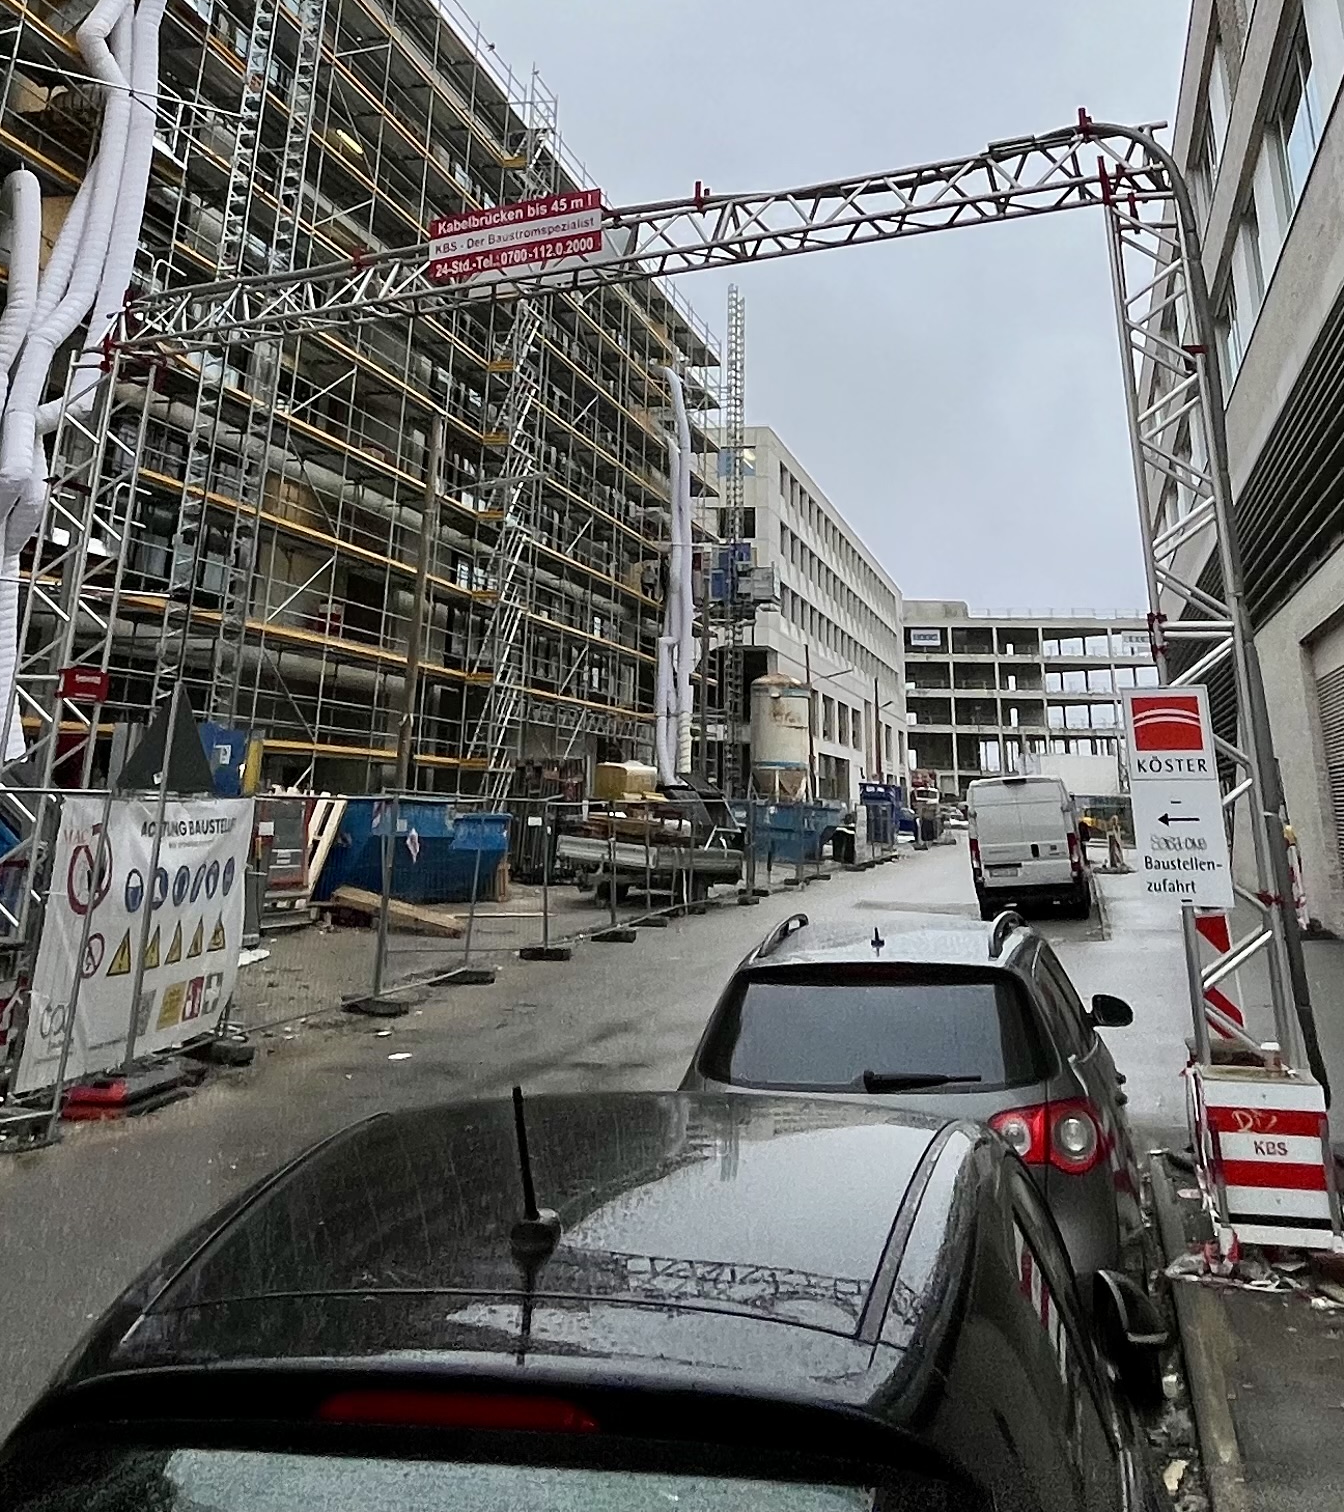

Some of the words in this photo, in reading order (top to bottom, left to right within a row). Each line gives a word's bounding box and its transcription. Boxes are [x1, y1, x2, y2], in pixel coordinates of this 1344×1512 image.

[437, 208, 524, 235] Kabelbrücken
[527, 203, 548, 218] bis
[551, 198, 568, 213] 45
[571, 197, 584, 210] m
[435, 241, 458, 255] KBS
[467, 236, 485, 249] Der
[488, 217, 595, 245] Baustromspezialist
[1137, 755, 1207, 773] KÖSTER
[1144, 855, 1223, 871] Baustellen-
[1146, 878, 1197, 894] zufahrt
[1253, 1140, 1288, 1156] KBS
